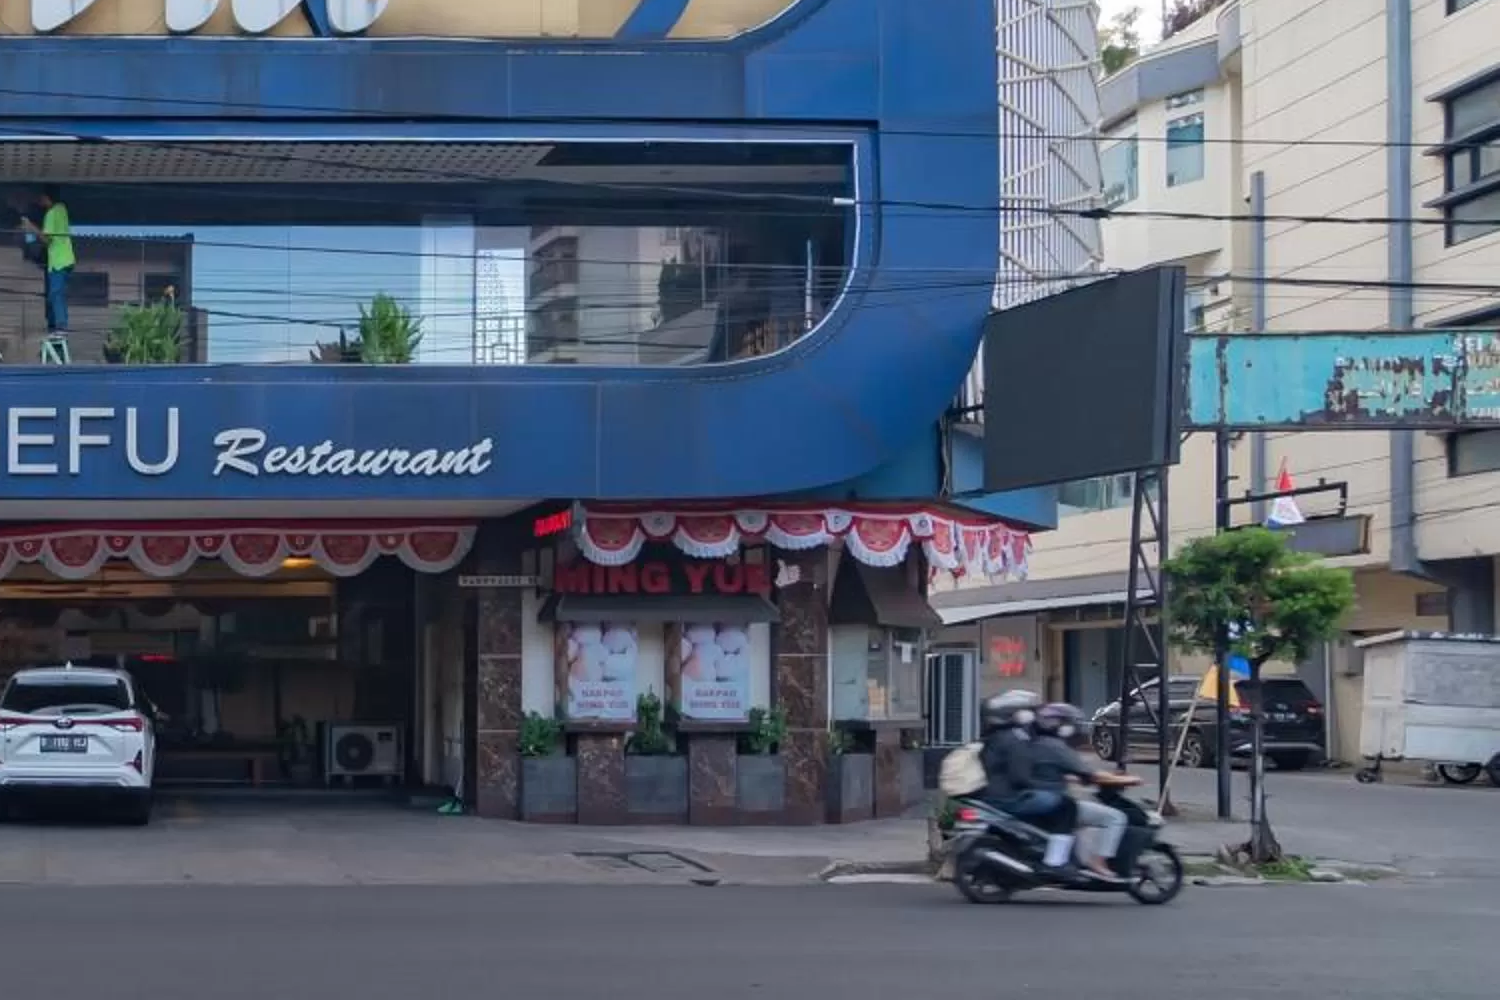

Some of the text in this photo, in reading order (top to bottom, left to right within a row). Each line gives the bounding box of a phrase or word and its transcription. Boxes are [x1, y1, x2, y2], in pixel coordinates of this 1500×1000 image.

[211, 427, 495, 477] Restaurant
[555, 561, 772, 594] MING YUE
